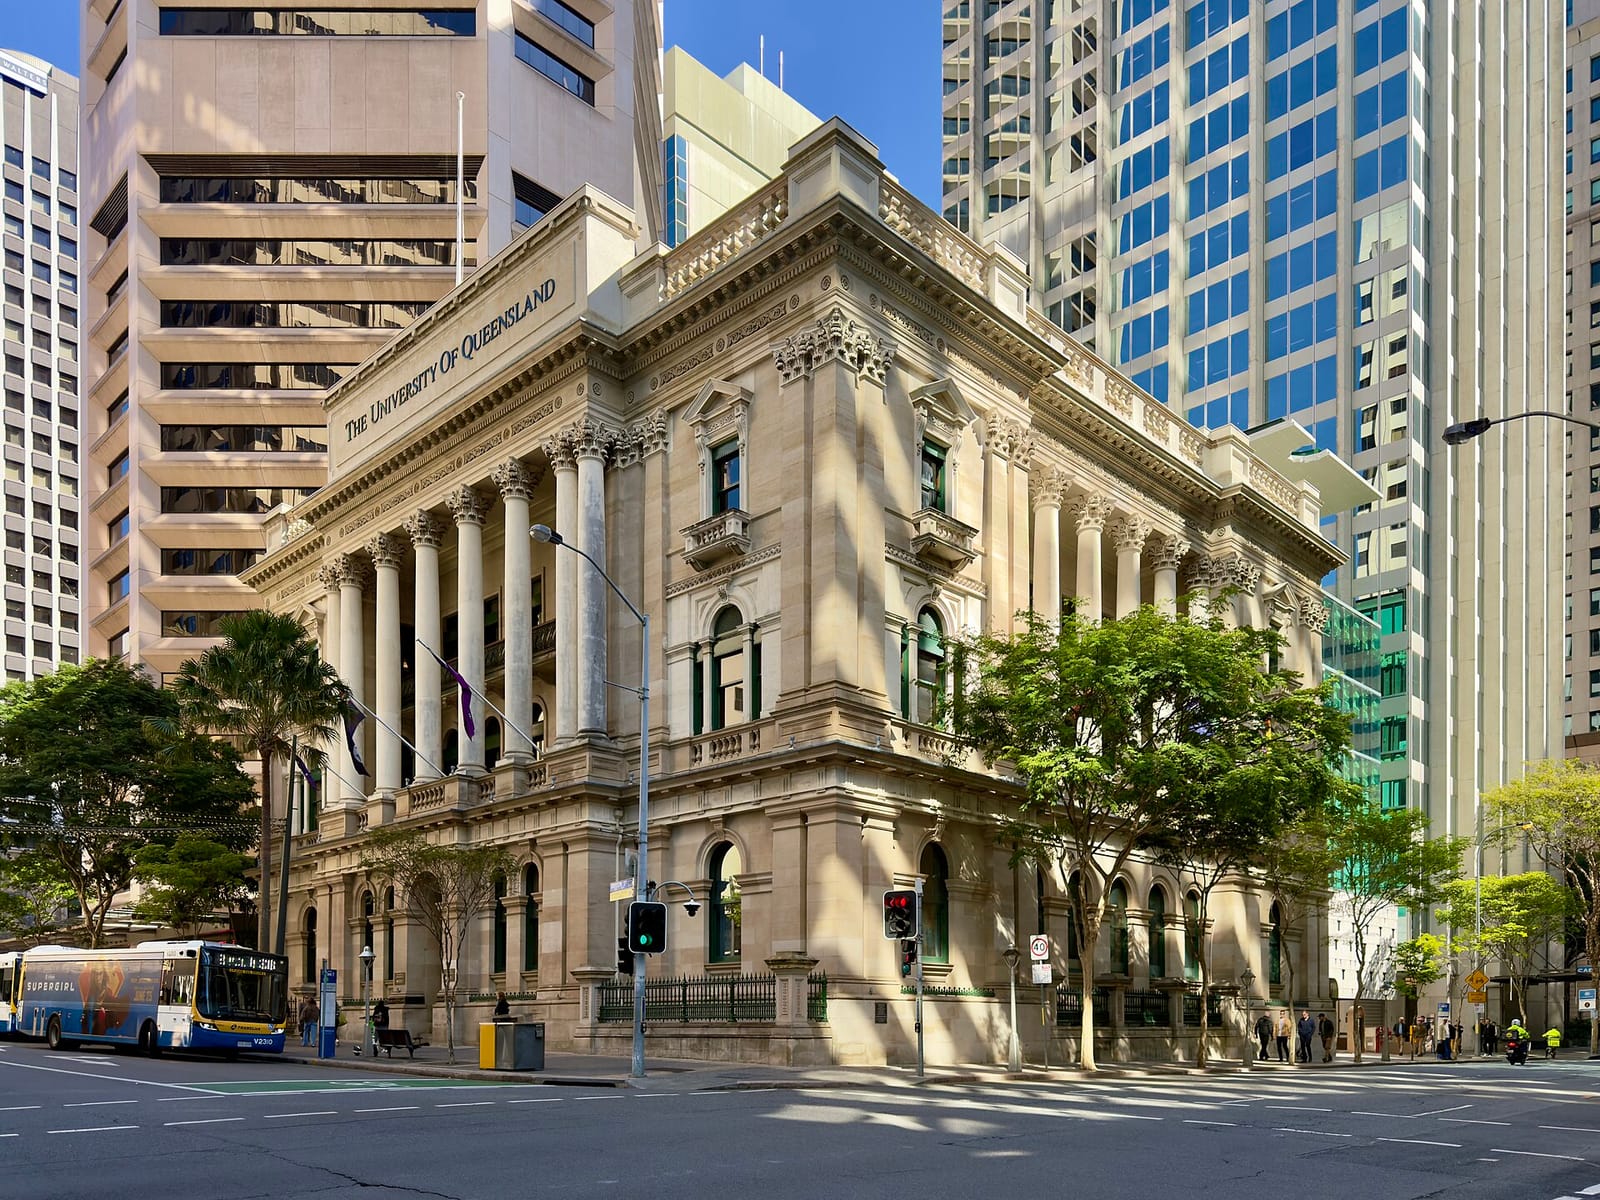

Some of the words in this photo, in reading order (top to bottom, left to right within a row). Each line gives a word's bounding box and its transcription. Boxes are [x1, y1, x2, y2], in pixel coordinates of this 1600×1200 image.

[3, 60, 47, 87] WALTERS
[345, 410, 368, 442] THE
[370, 362, 438, 424] UNIVERSITY
[461, 278, 556, 360] QUEENSLAND
[1034, 943, 1045, 951] 40
[27, 982, 75, 991] SUPERGIRL
